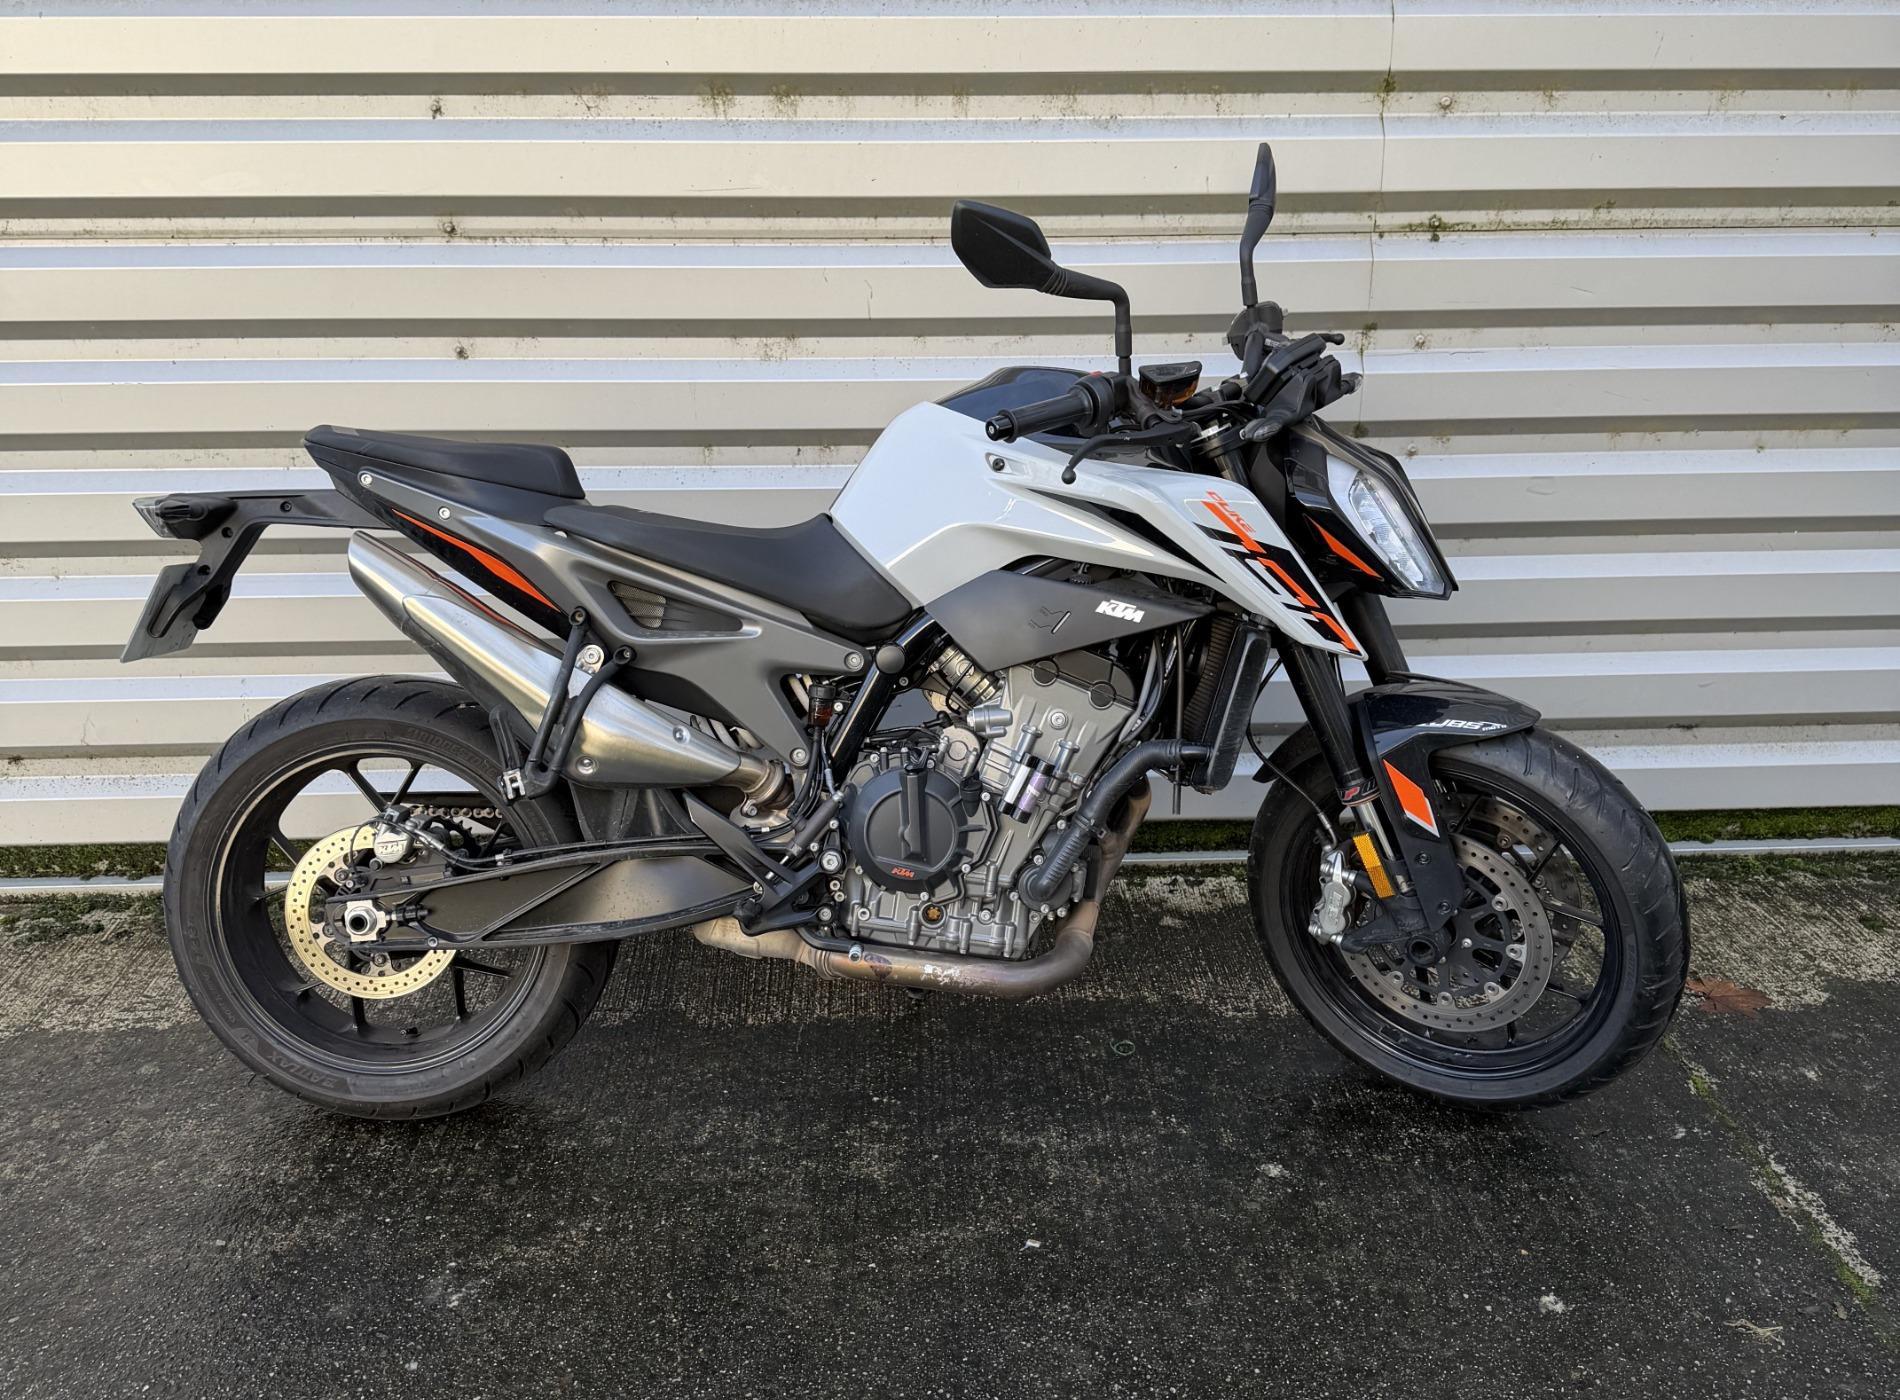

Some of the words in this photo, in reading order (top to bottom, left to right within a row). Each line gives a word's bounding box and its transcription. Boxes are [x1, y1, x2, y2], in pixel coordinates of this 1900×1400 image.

[1206, 490, 1256, 534] DUKE
[1095, 599, 1145, 623] KTM
[891, 867, 915, 879] KTM
[266, 1050, 337, 1088] BATTLAX
